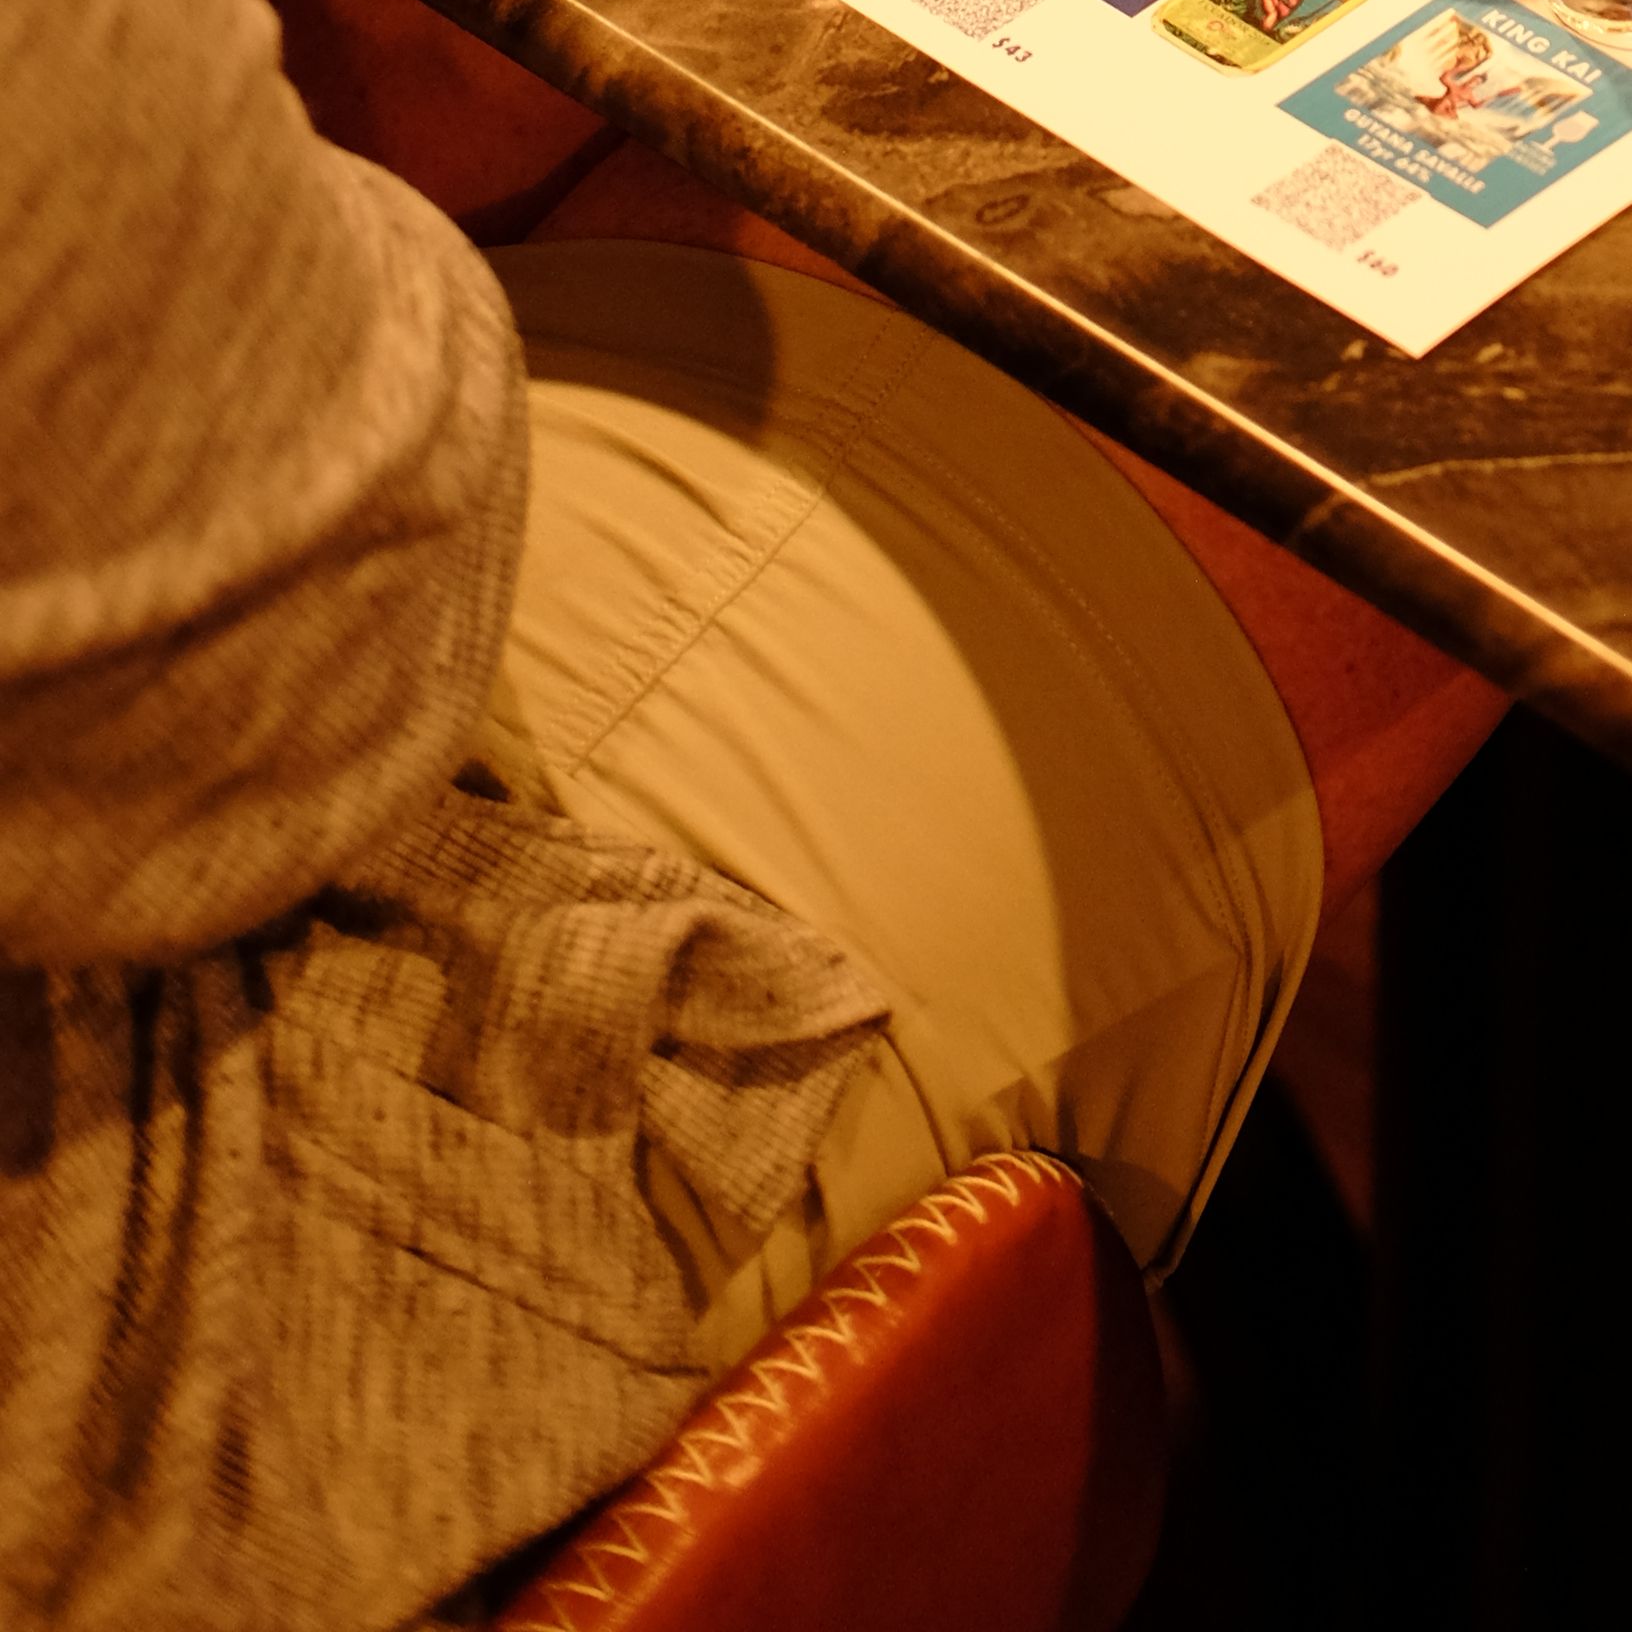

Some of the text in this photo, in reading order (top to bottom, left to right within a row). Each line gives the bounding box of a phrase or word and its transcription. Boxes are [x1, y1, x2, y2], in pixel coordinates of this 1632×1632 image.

[992, 37, 1033, 63] $43
[1481, 9, 1602, 84] KING KAI
[1344, 108, 1414, 155] GUYANA
